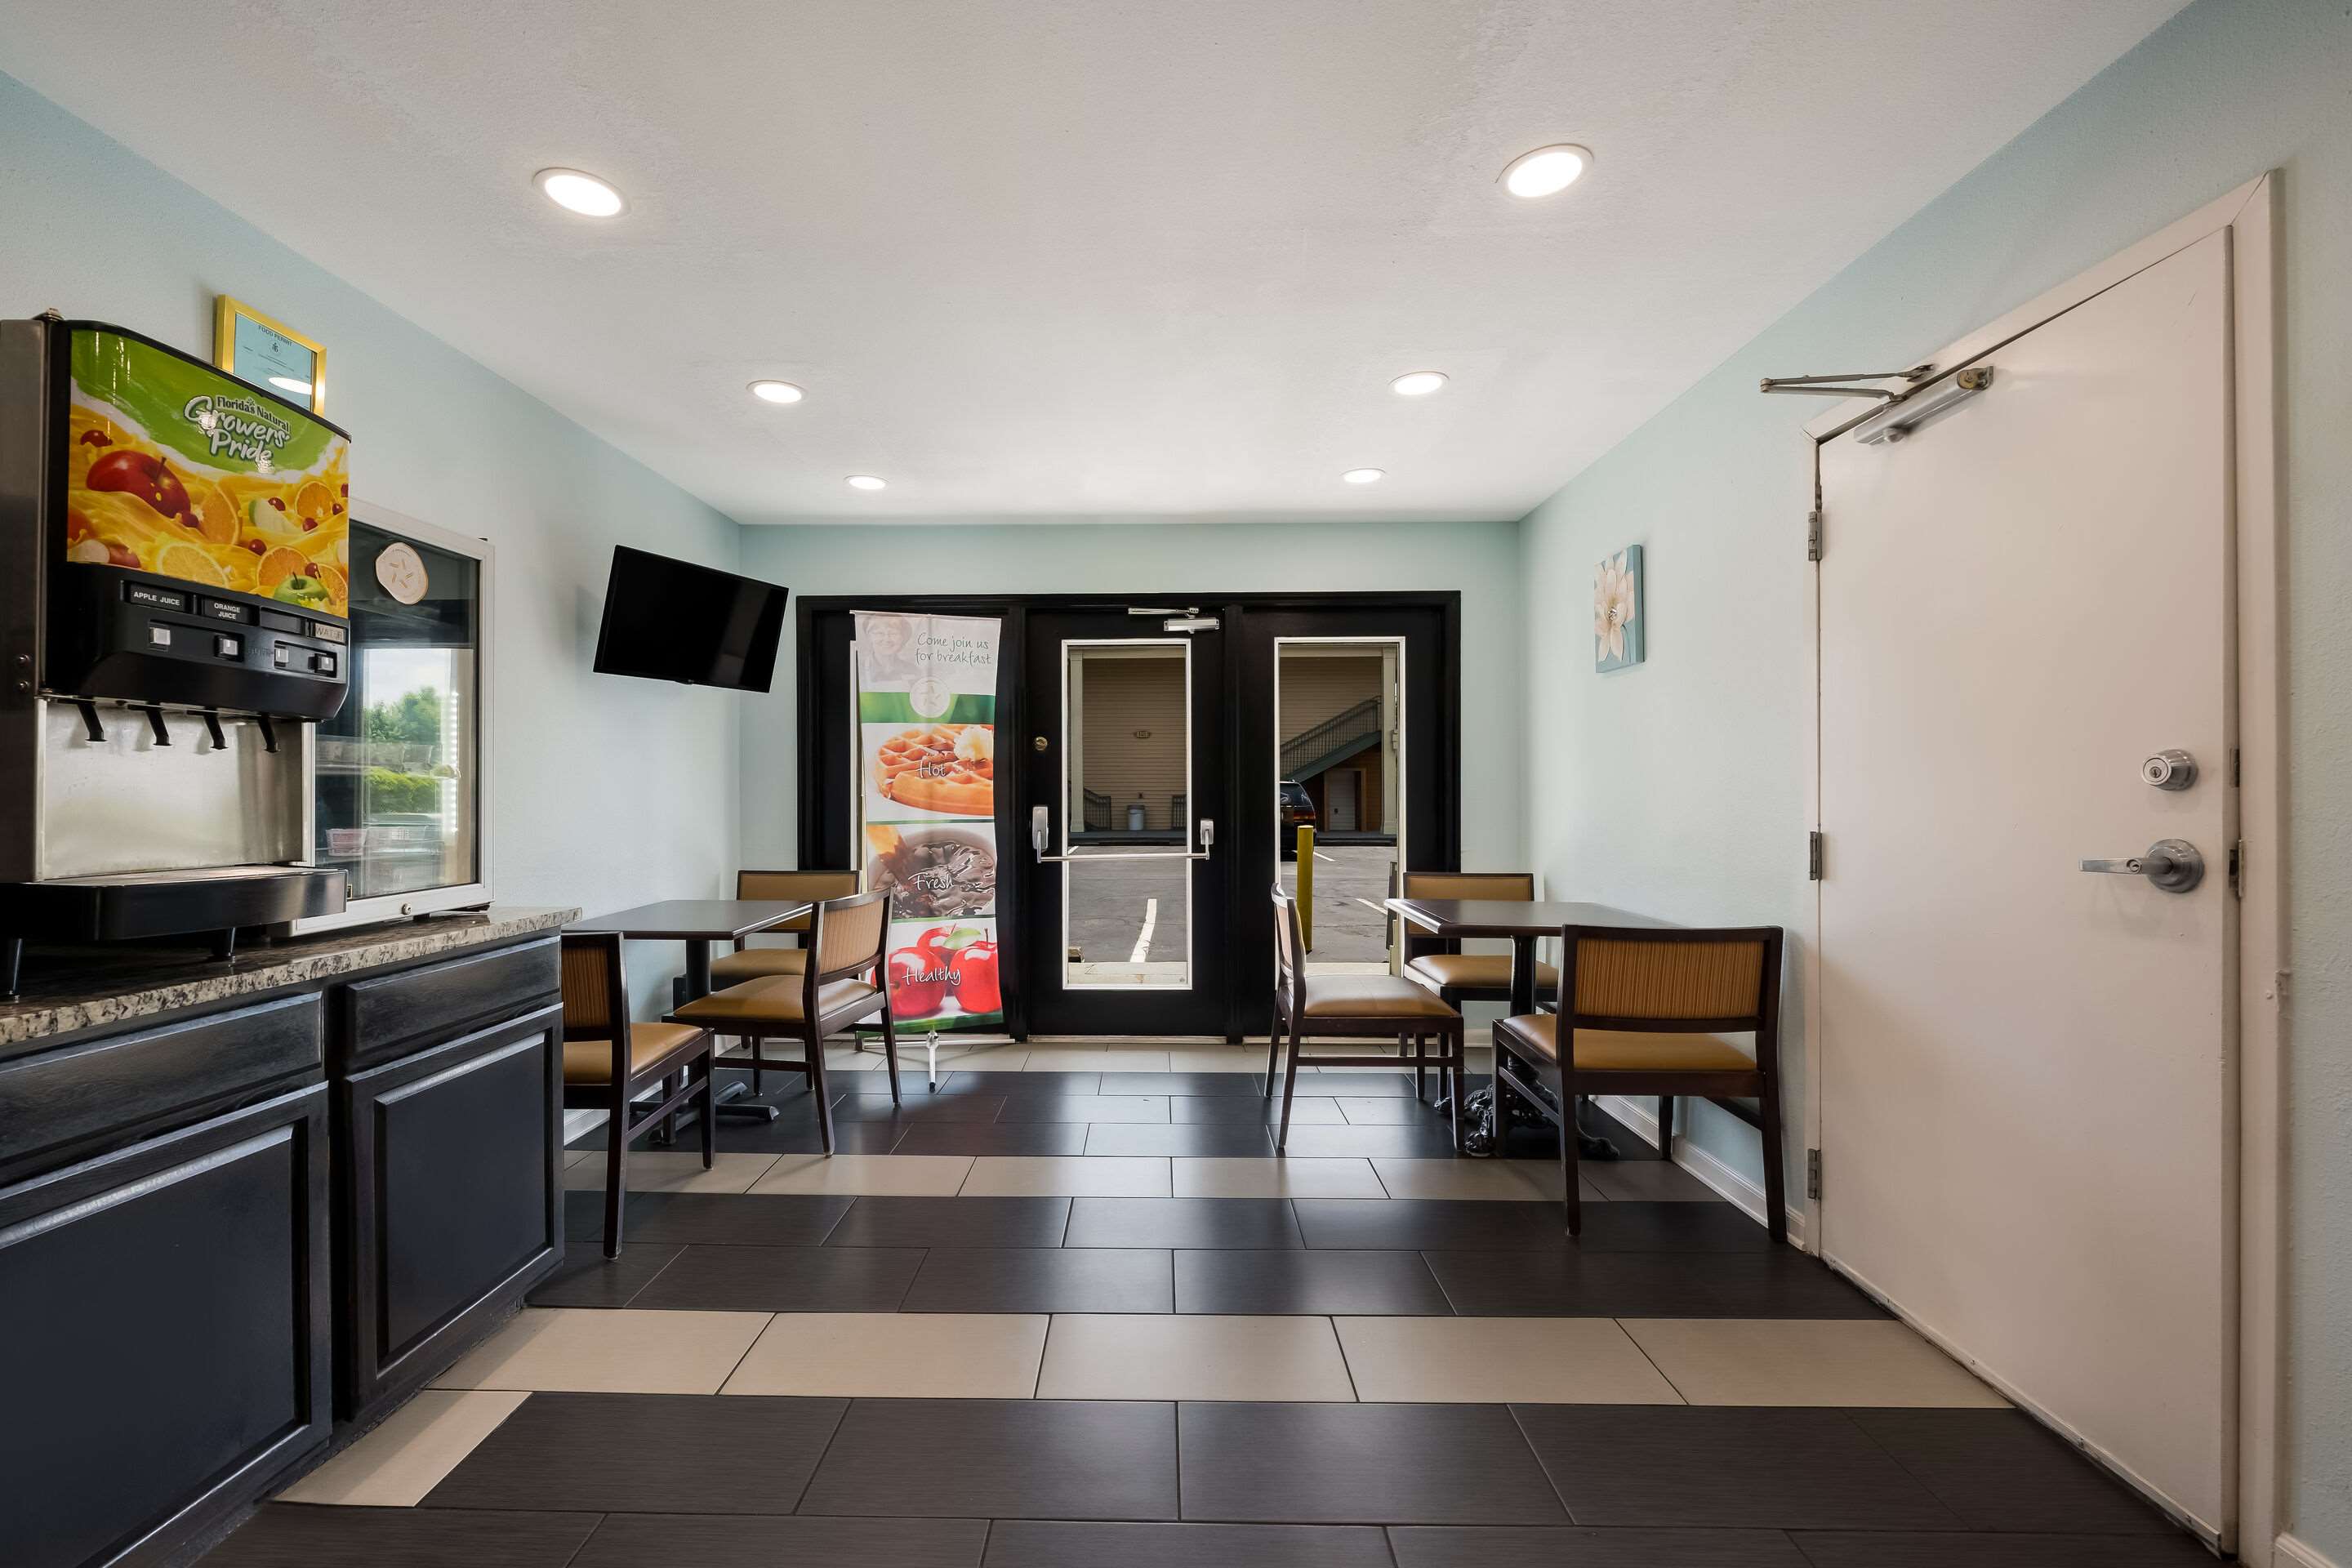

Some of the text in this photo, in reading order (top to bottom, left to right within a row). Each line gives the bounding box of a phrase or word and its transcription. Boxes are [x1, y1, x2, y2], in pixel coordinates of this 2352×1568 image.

[256, 406, 290, 432] Natural
[209, 428, 273, 460] Pride
[133, 591, 180, 606] APPLE JUICE
[214, 603, 241, 613] ORANGE
[218, 612, 236, 620] JUICE
[917, 632, 988, 653] Come join us
[915, 648, 993, 667] for breakfast
[917, 761, 946, 778] Hot
[907, 871, 954, 890] Fresh
[902, 966, 961, 986] Healthy
